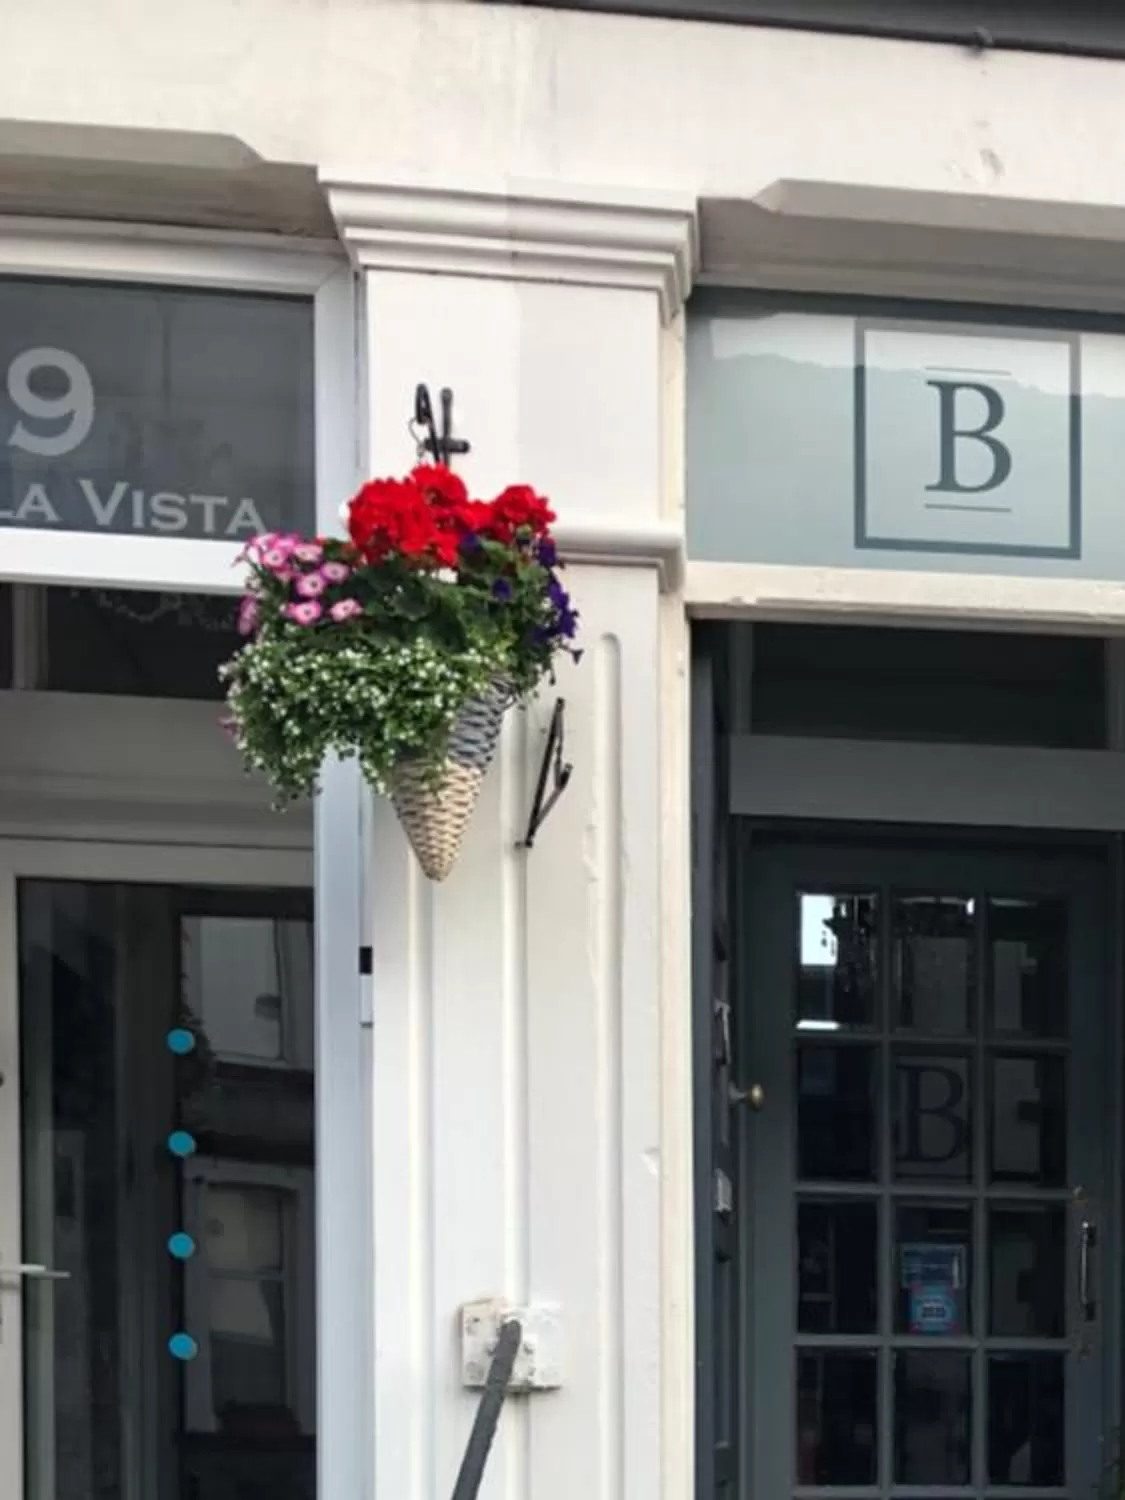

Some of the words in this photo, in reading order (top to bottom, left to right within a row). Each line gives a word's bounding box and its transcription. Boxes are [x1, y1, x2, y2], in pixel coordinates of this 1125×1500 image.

[7, 345, 95, 457] 9
[925, 379, 1012, 493] B
[77, 478, 268, 535] VISTA
